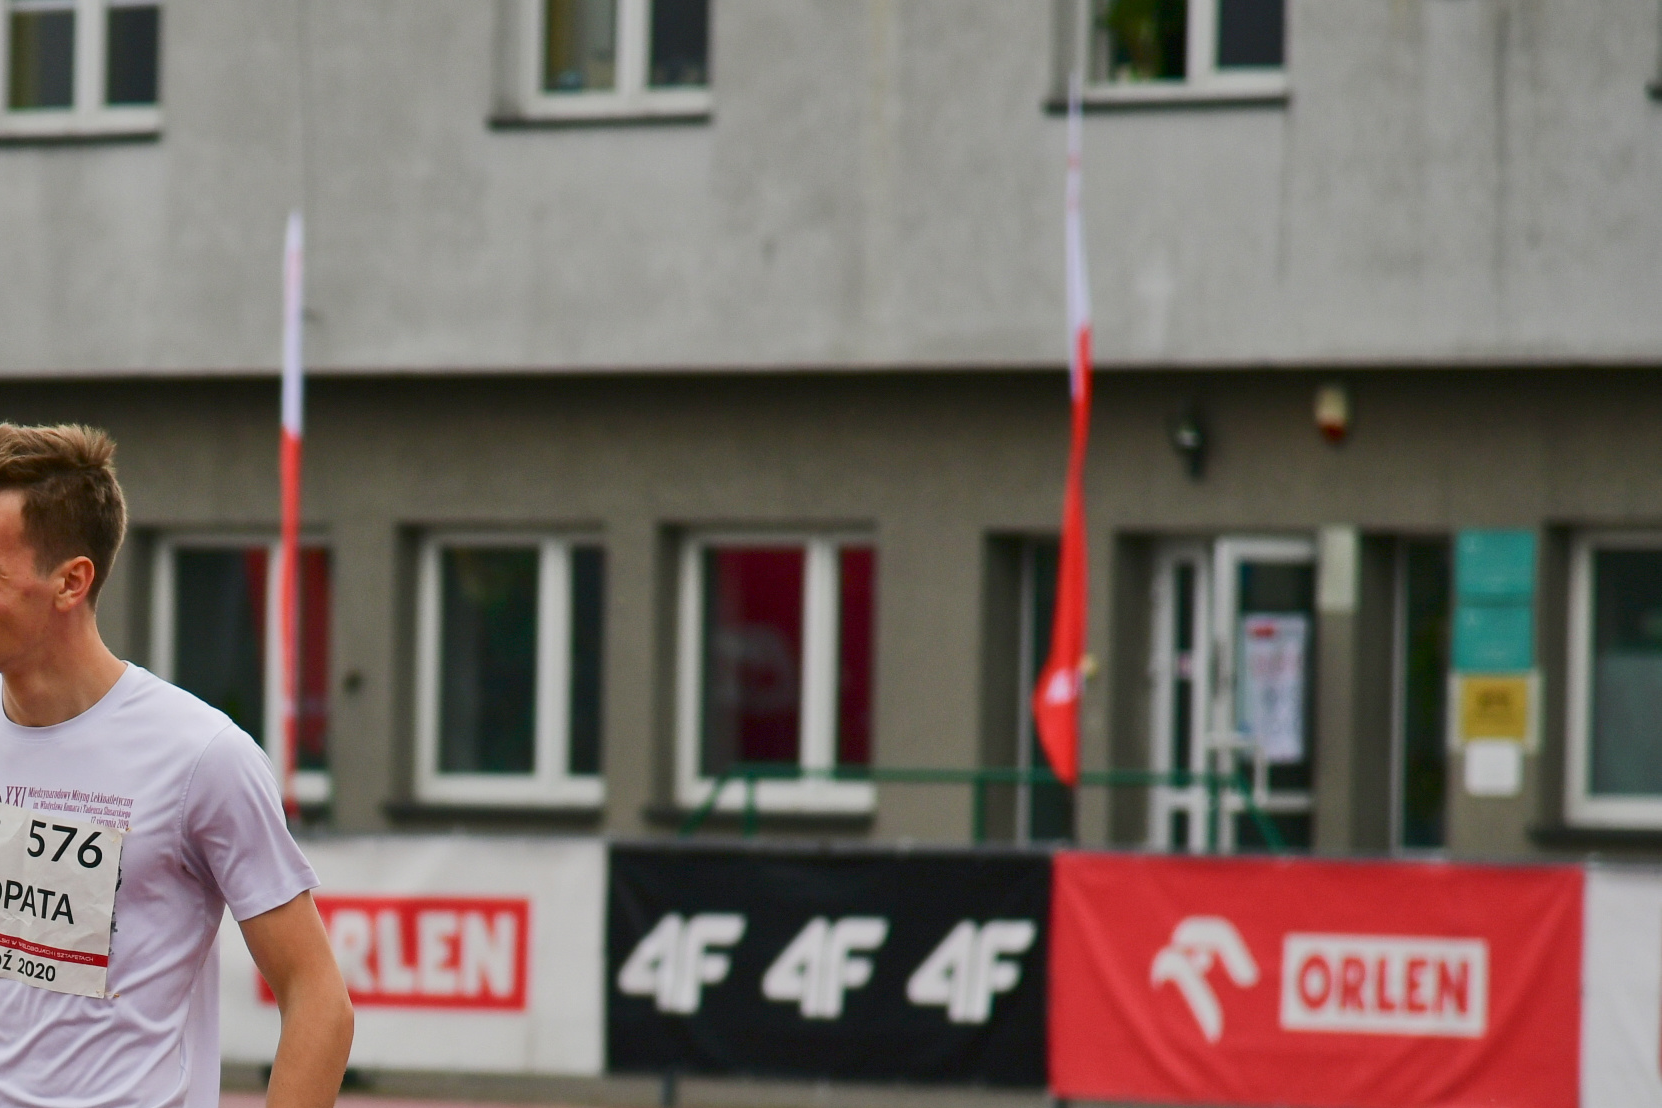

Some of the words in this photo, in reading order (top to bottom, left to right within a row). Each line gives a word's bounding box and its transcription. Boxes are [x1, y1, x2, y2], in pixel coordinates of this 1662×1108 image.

[5, 786, 27, 808] XXI
[27, 819, 103, 869] 576
[17, 957, 56, 982] 2020
[329, 908, 518, 998] RLEN
[618, 912, 747, 1016] 4F
[761, 916, 890, 1020] 4F
[905, 919, 1037, 1024] 4F
[1297, 953, 1471, 1018] ORLEN
